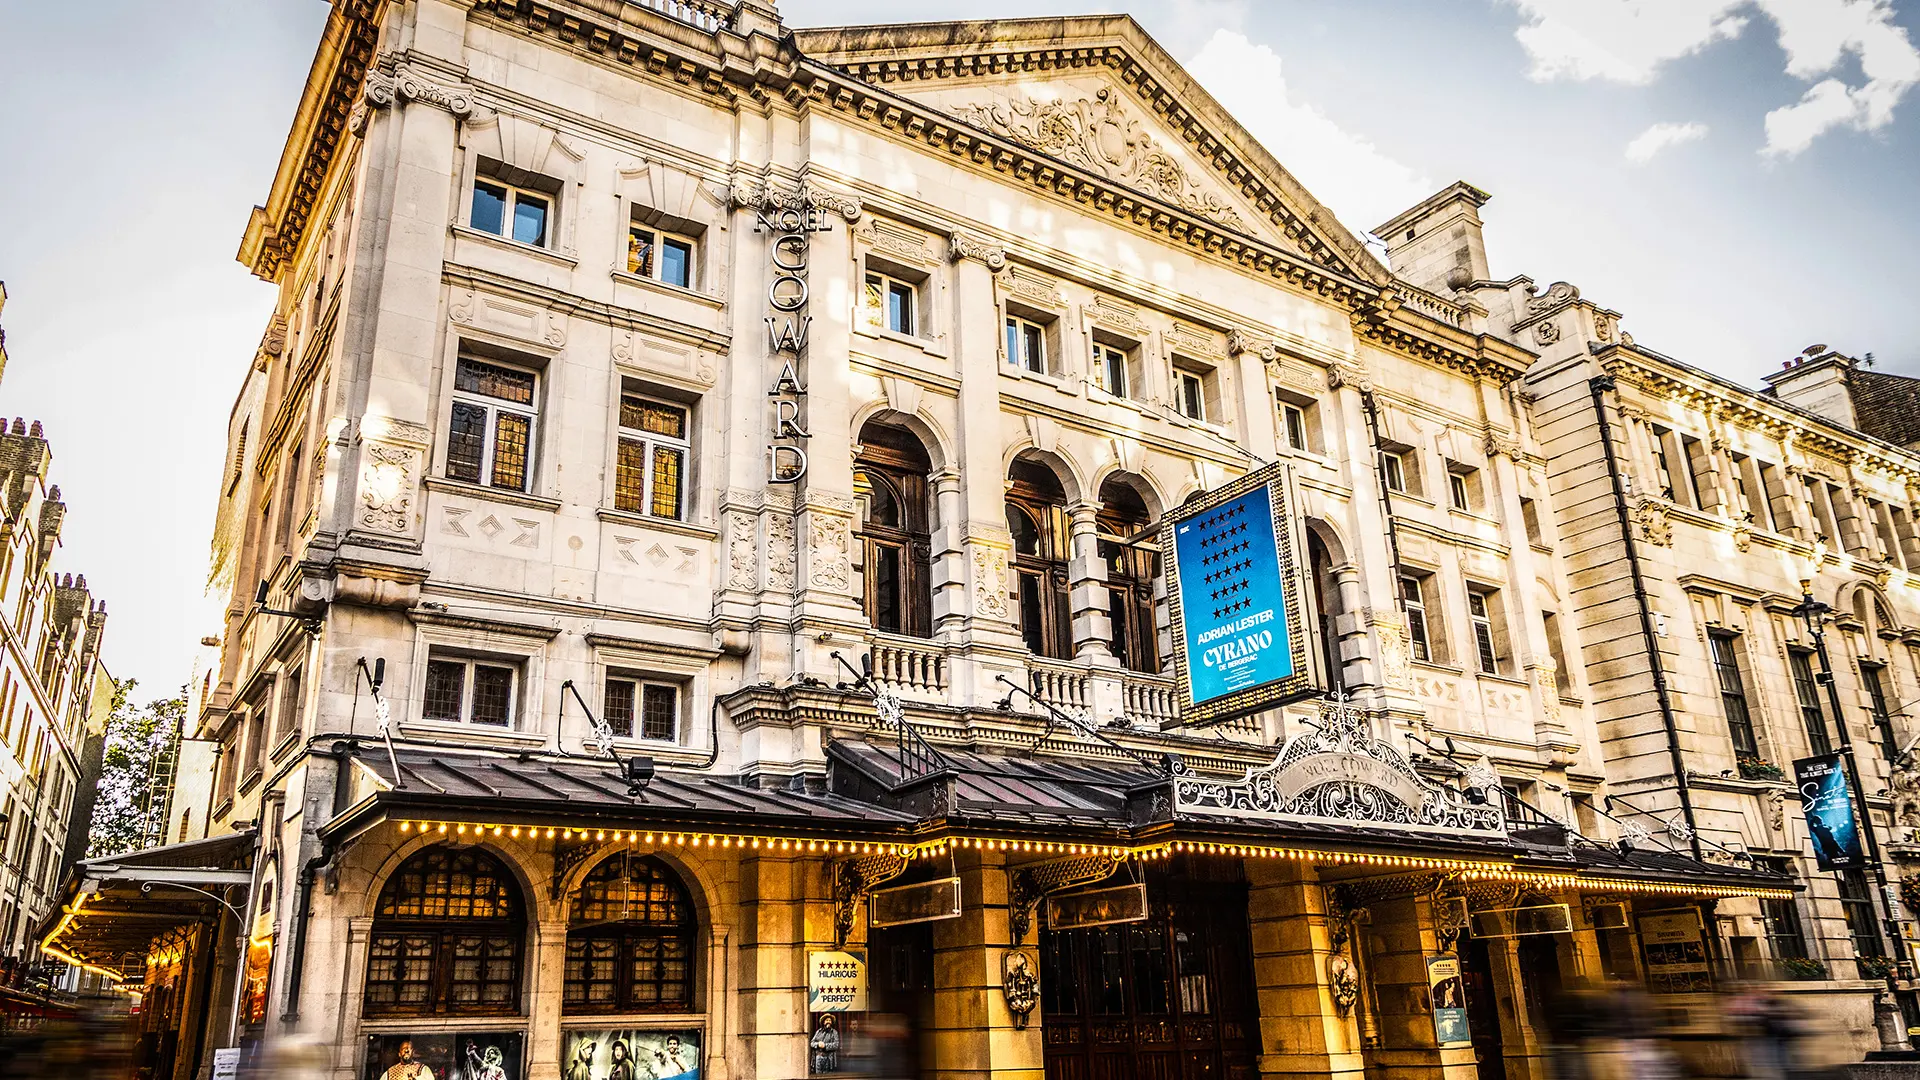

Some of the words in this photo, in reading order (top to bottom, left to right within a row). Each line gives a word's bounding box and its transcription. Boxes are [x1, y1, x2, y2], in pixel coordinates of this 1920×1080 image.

[753, 204, 832, 233] NOËL
[764, 234, 812, 485] COWARD
[1197, 622, 1235, 645] ADRIAN
[1235, 609, 1274, 632] LESTER
[1203, 629, 1273, 667] CYRANO
[1227, 654, 1258, 669] BERGERAC
[1341, 757, 1397, 787] COWRD
